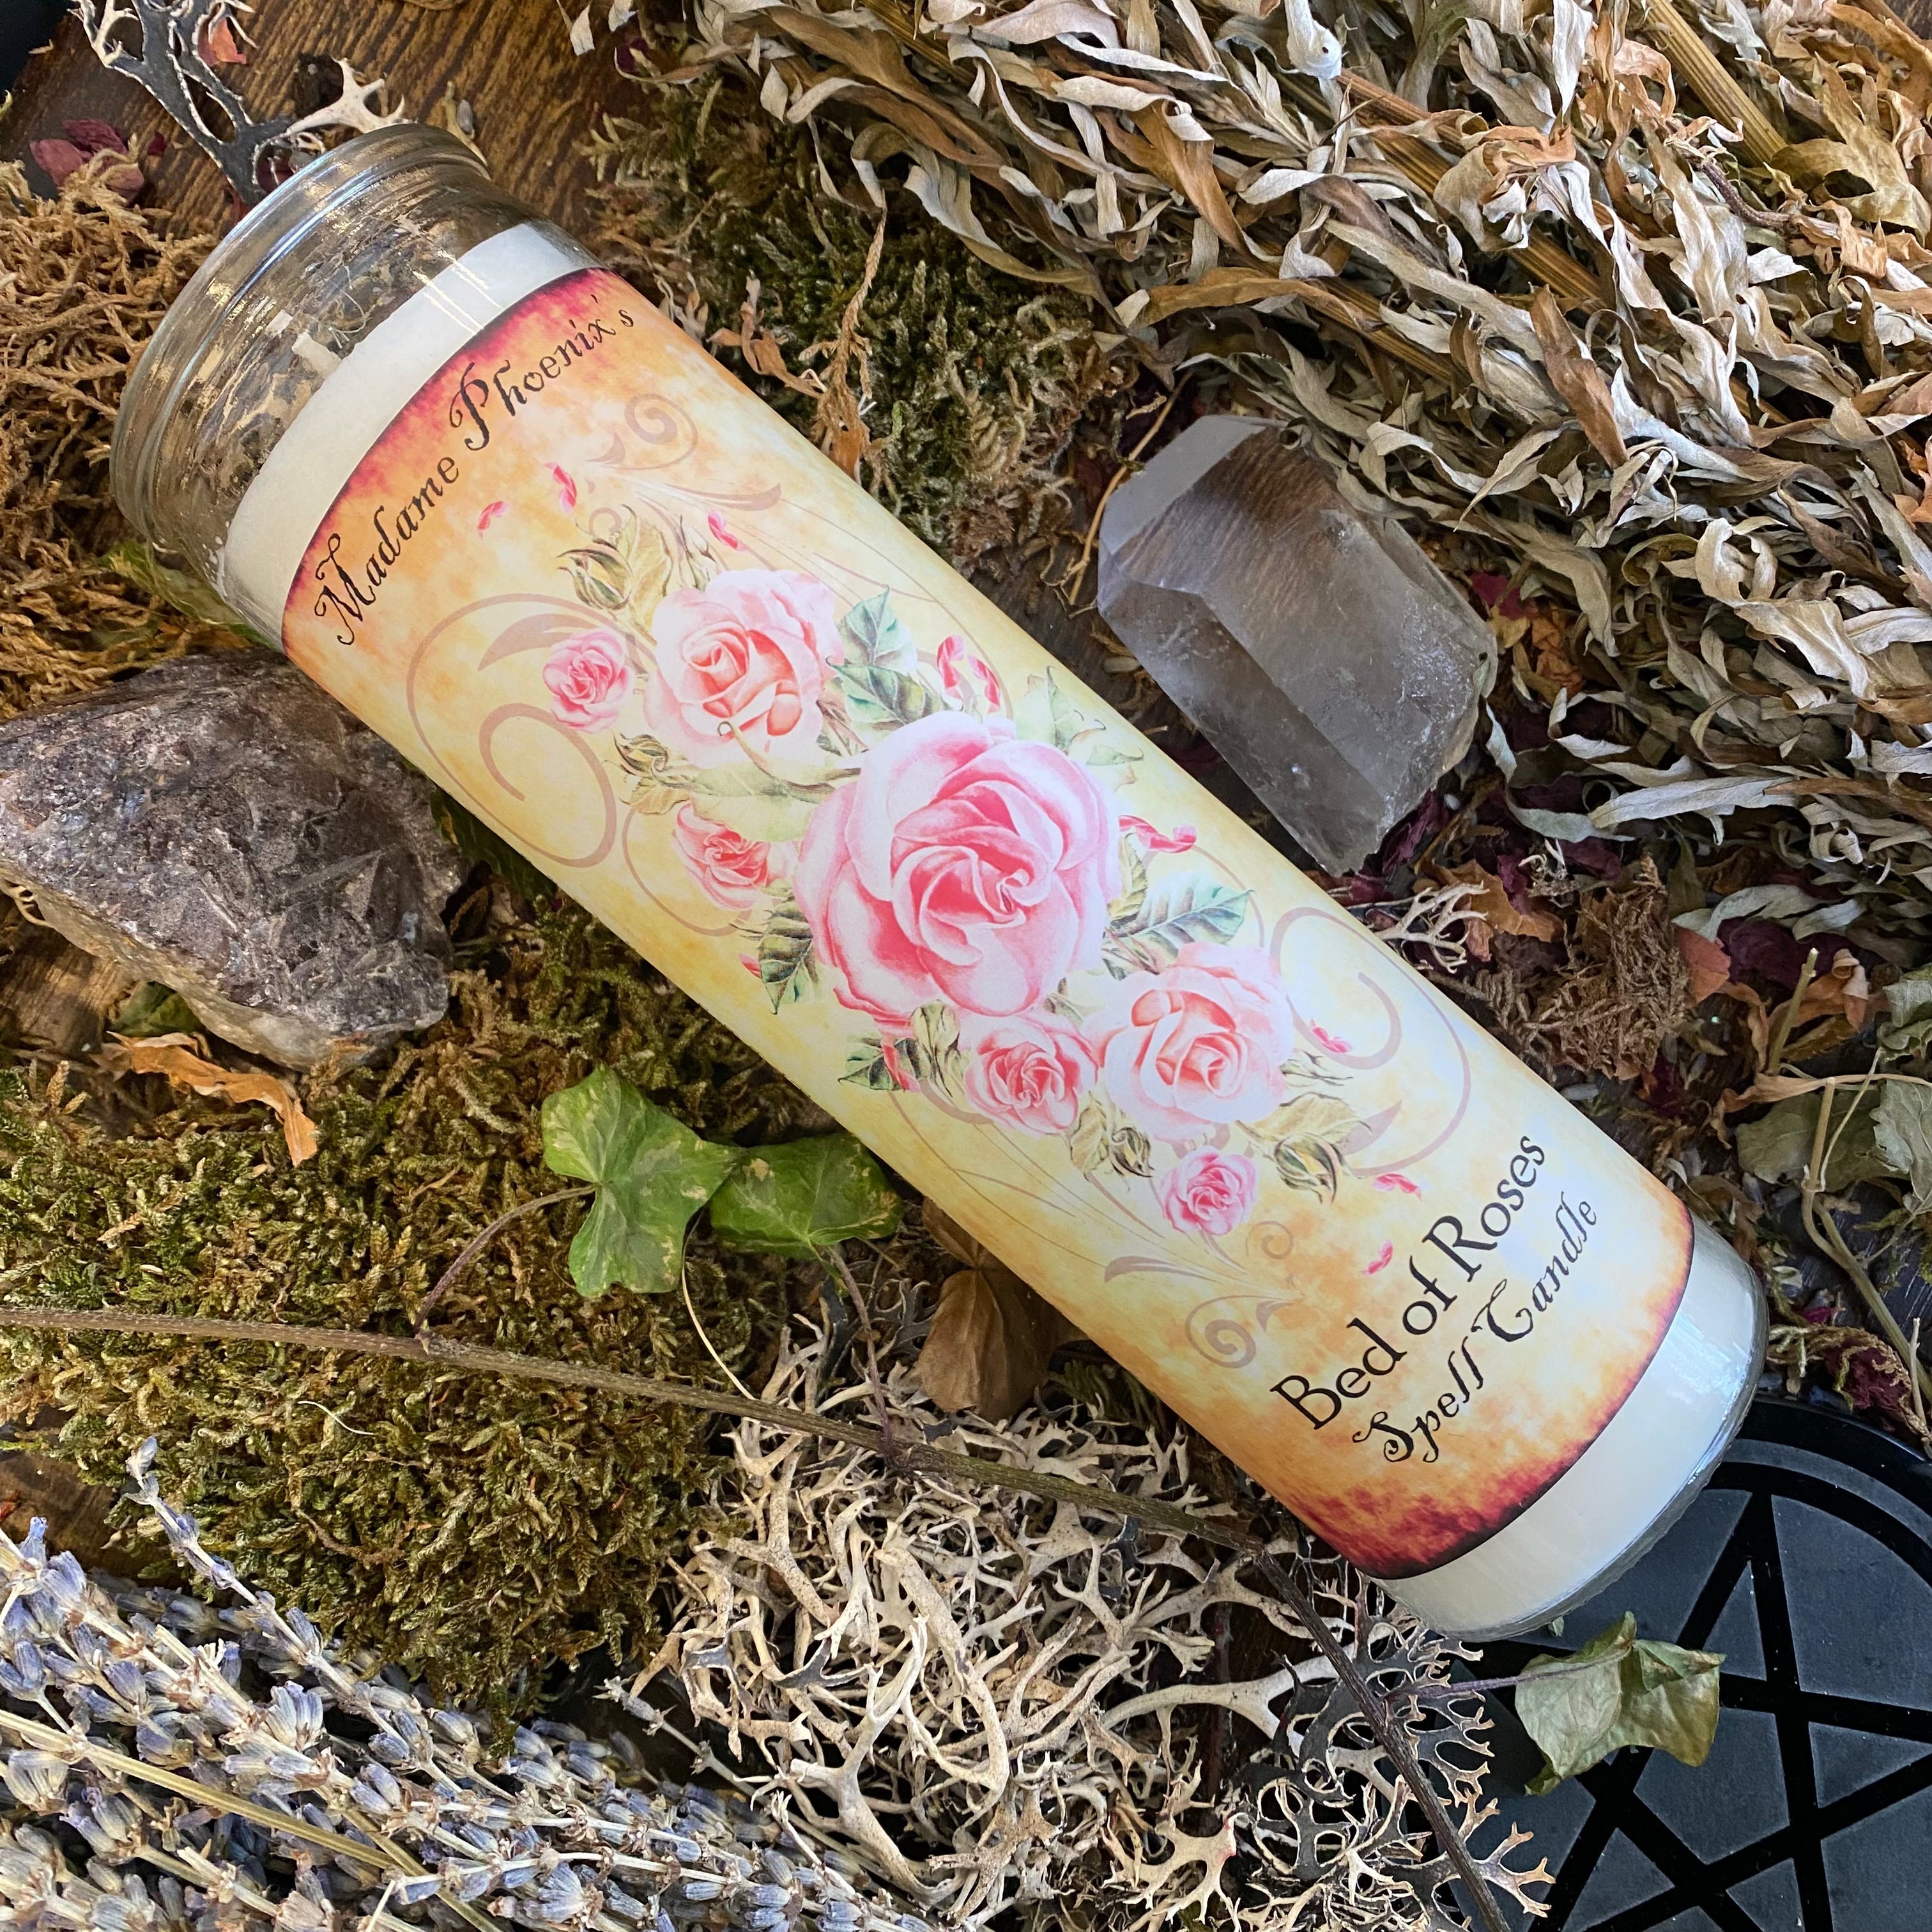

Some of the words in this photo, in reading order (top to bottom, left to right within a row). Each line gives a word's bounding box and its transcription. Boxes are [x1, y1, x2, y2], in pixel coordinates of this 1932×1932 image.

[314, 456, 459, 645] Madame
[448, 294, 634, 451] Phoenix's
[1422, 1135, 1545, 1283] Roses
[1352, 1335, 1484, 1463] Spell
[1470, 1191, 1598, 1342] Candle
[1402, 1254, 1458, 1336] of
[1269, 1317, 1408, 1430] Bed
